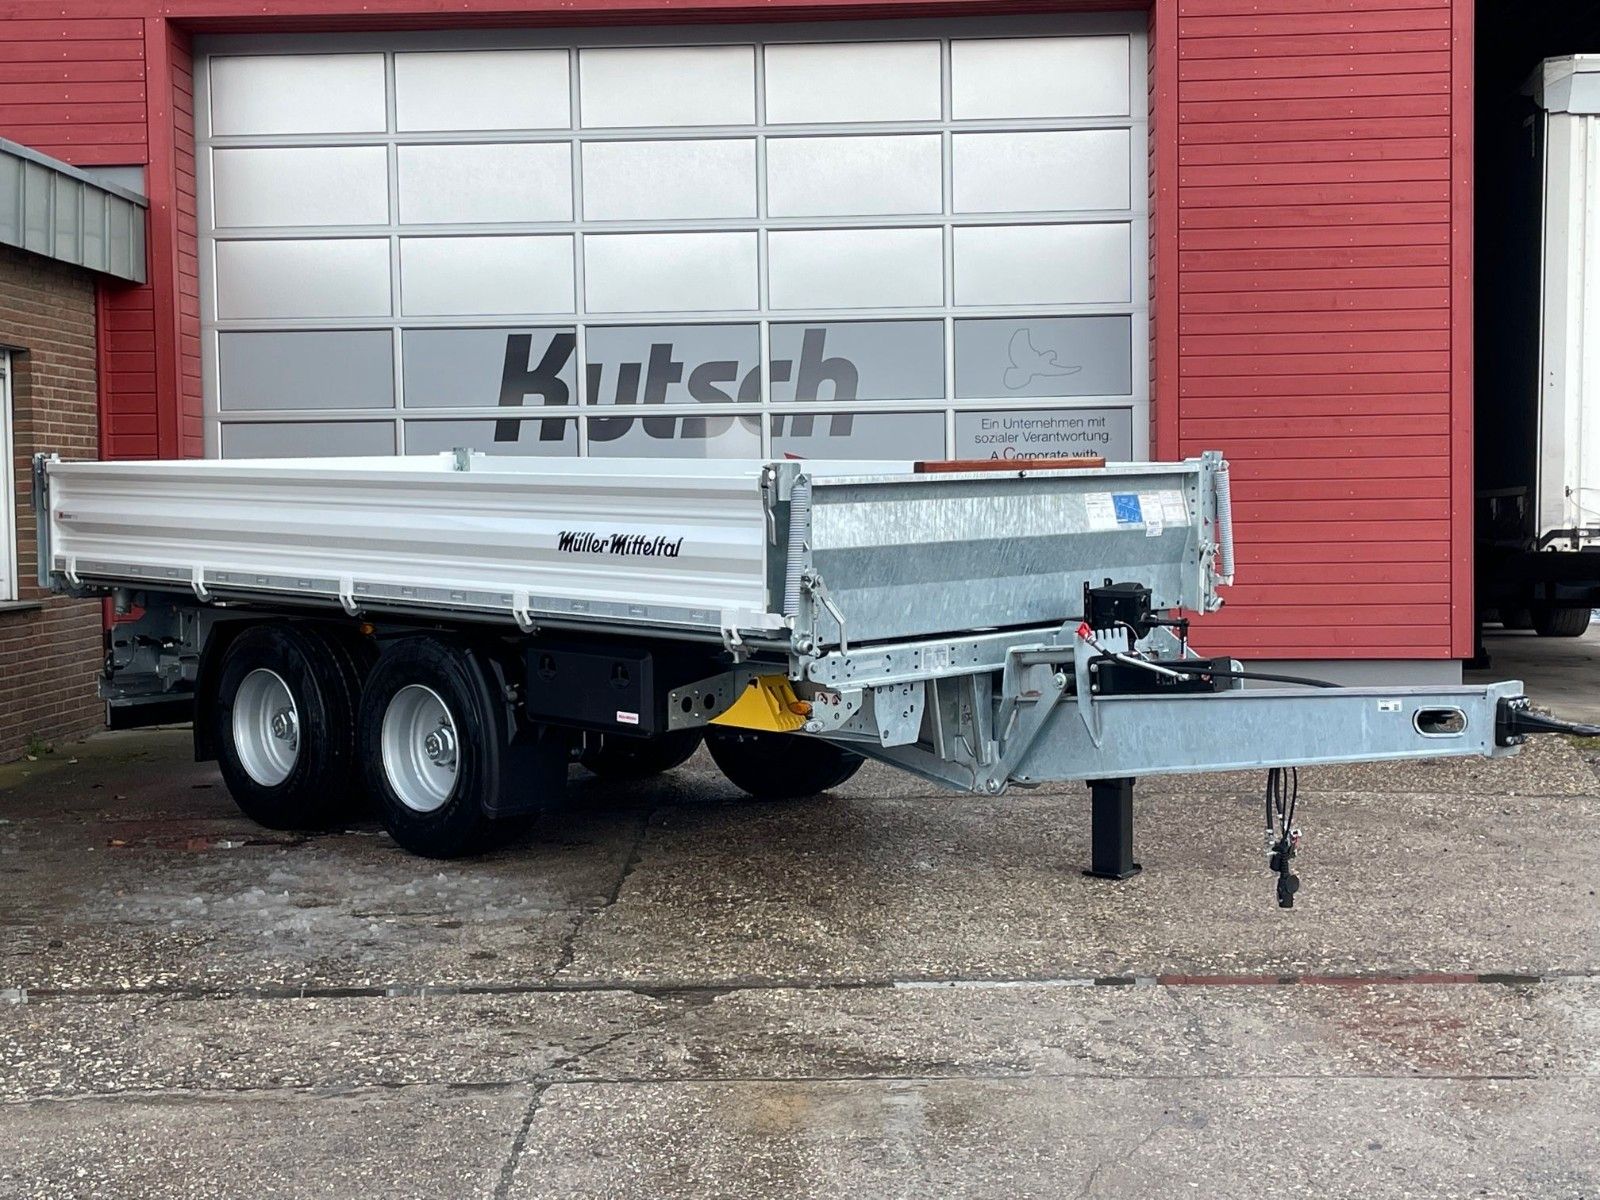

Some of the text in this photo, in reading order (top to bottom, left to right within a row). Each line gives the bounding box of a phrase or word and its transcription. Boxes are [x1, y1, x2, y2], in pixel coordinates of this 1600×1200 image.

[494, 328, 859, 442] Kutsch
[981, 417, 1106, 430] Ein Unternehmen mit
[974, 430, 1113, 444] sozialer Verantwortung.
[990, 446, 1098, 460] A Corporate with
[557, 531, 684, 558] Müller Mitteltal
